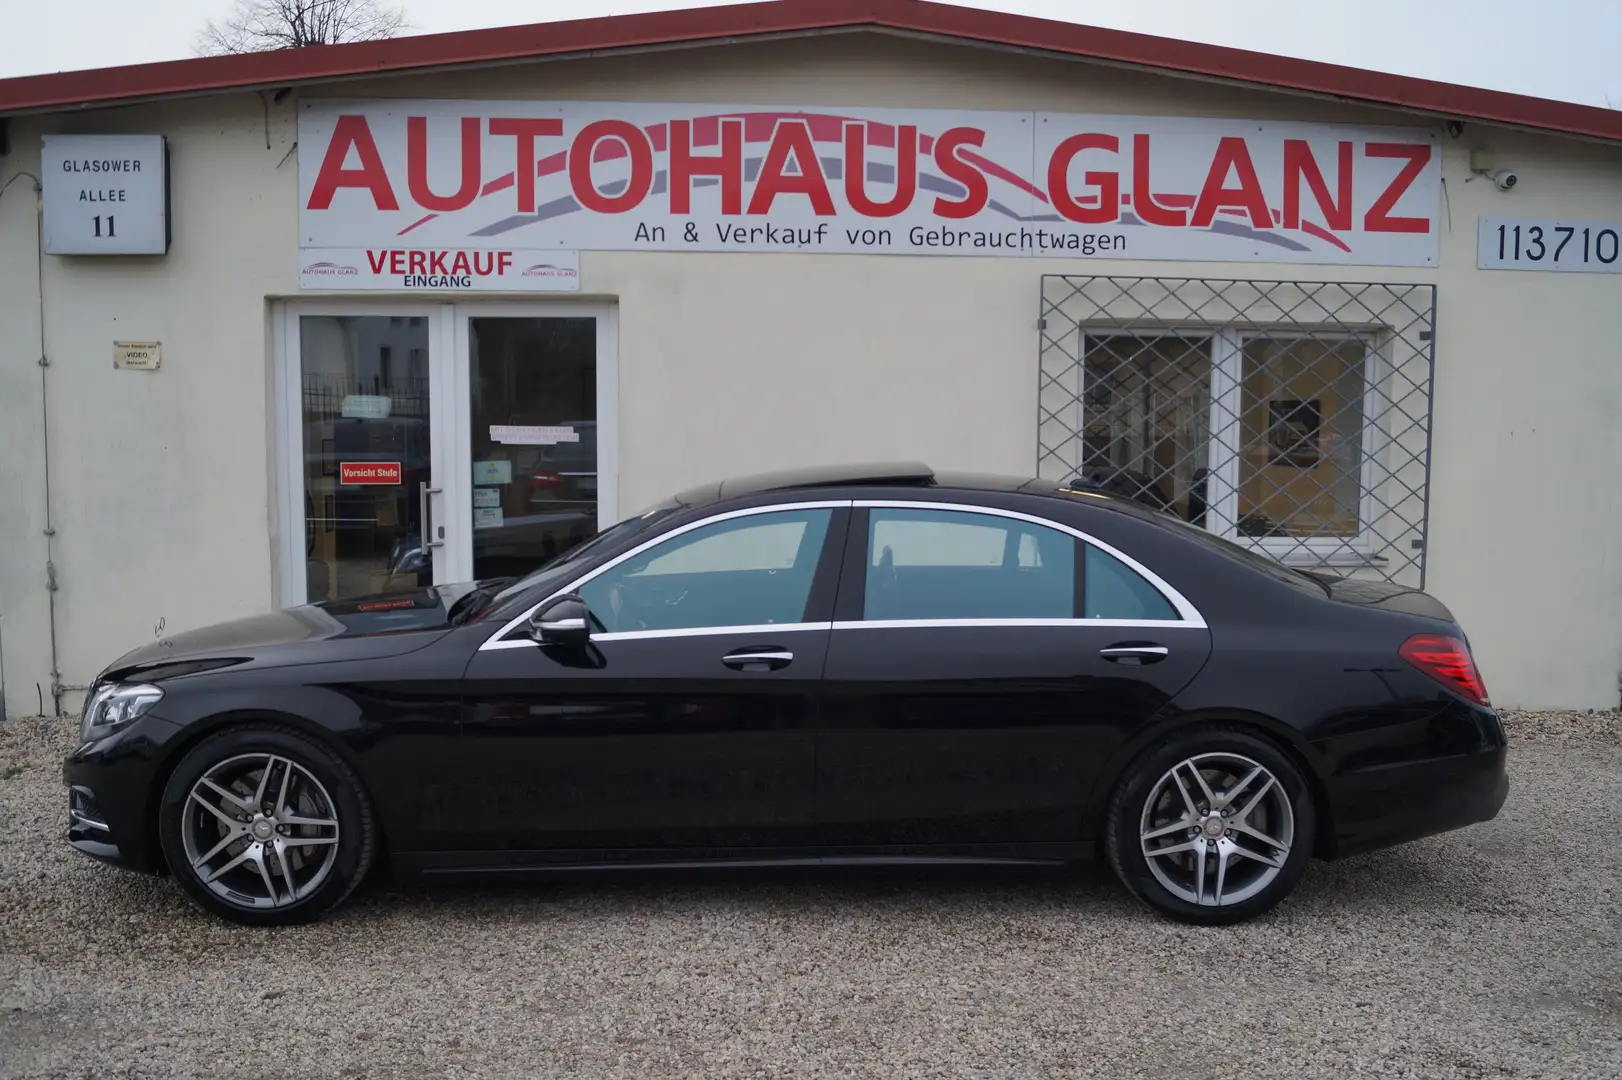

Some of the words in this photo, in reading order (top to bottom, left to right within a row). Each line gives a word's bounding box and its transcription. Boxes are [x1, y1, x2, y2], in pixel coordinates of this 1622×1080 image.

[63, 160, 141, 172] GLASOWER
[306, 114, 989, 219] AUTOHAUS
[1047, 132, 1432, 234] GLANZ
[79, 189, 126, 202] ALLEE
[92, 214, 116, 237] 11
[634, 222, 666, 242] An
[683, 222, 699, 243] &
[716, 222, 828, 245] Verkauf
[846, 229, 892, 246] von
[909, 225, 1126, 256] Gebrauchtwagen
[1497, 224, 1619, 264] 113710
[366, 249, 513, 276] VERKAUF
[302, 268, 336, 276] AUTOHAUS
[404, 275, 471, 288] EINGANG
[126, 351, 148, 359] VIDEO
[343, 468, 376, 477] Vorsicht
[377, 468, 398, 478] Stufe
